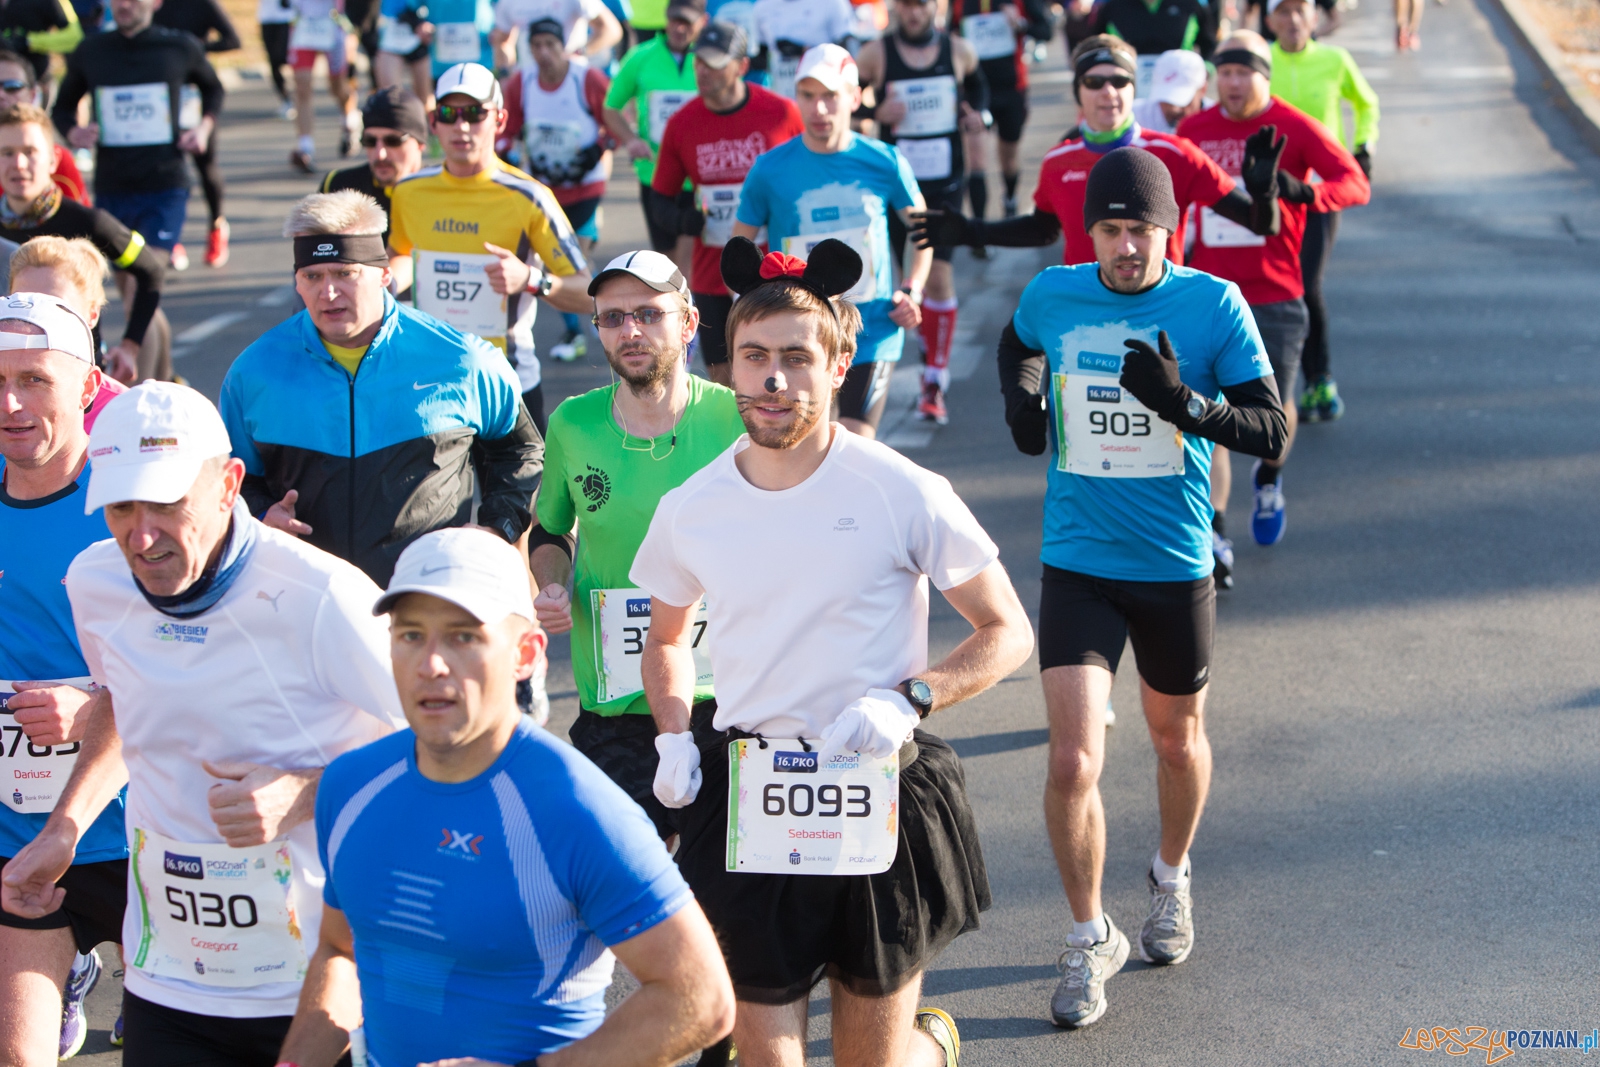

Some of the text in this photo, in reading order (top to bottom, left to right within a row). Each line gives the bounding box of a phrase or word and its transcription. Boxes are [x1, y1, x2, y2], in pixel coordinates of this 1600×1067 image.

[436, 280, 482, 302] 857
[1081, 356, 1117, 369] 16. PKO
[1101, 391, 1119, 400] PKO
[1089, 410, 1151, 437] 903
[1100, 444, 1142, 453] Sebastian
[629, 603, 652, 612] 16. PK
[174, 624, 209, 636] BIEGIEM
[623, 620, 708, 655] 37
[777, 756, 815, 768] 16. PKO
[14, 769, 52, 779] Dariusz
[762, 783, 872, 818] 6093
[788, 829, 842, 840] Sebastian
[165, 857, 200, 874] 16. PKO
[207, 868, 247, 878] maraton
[165, 885, 258, 928] 5130
[191, 936, 239, 952] Grzegorz
